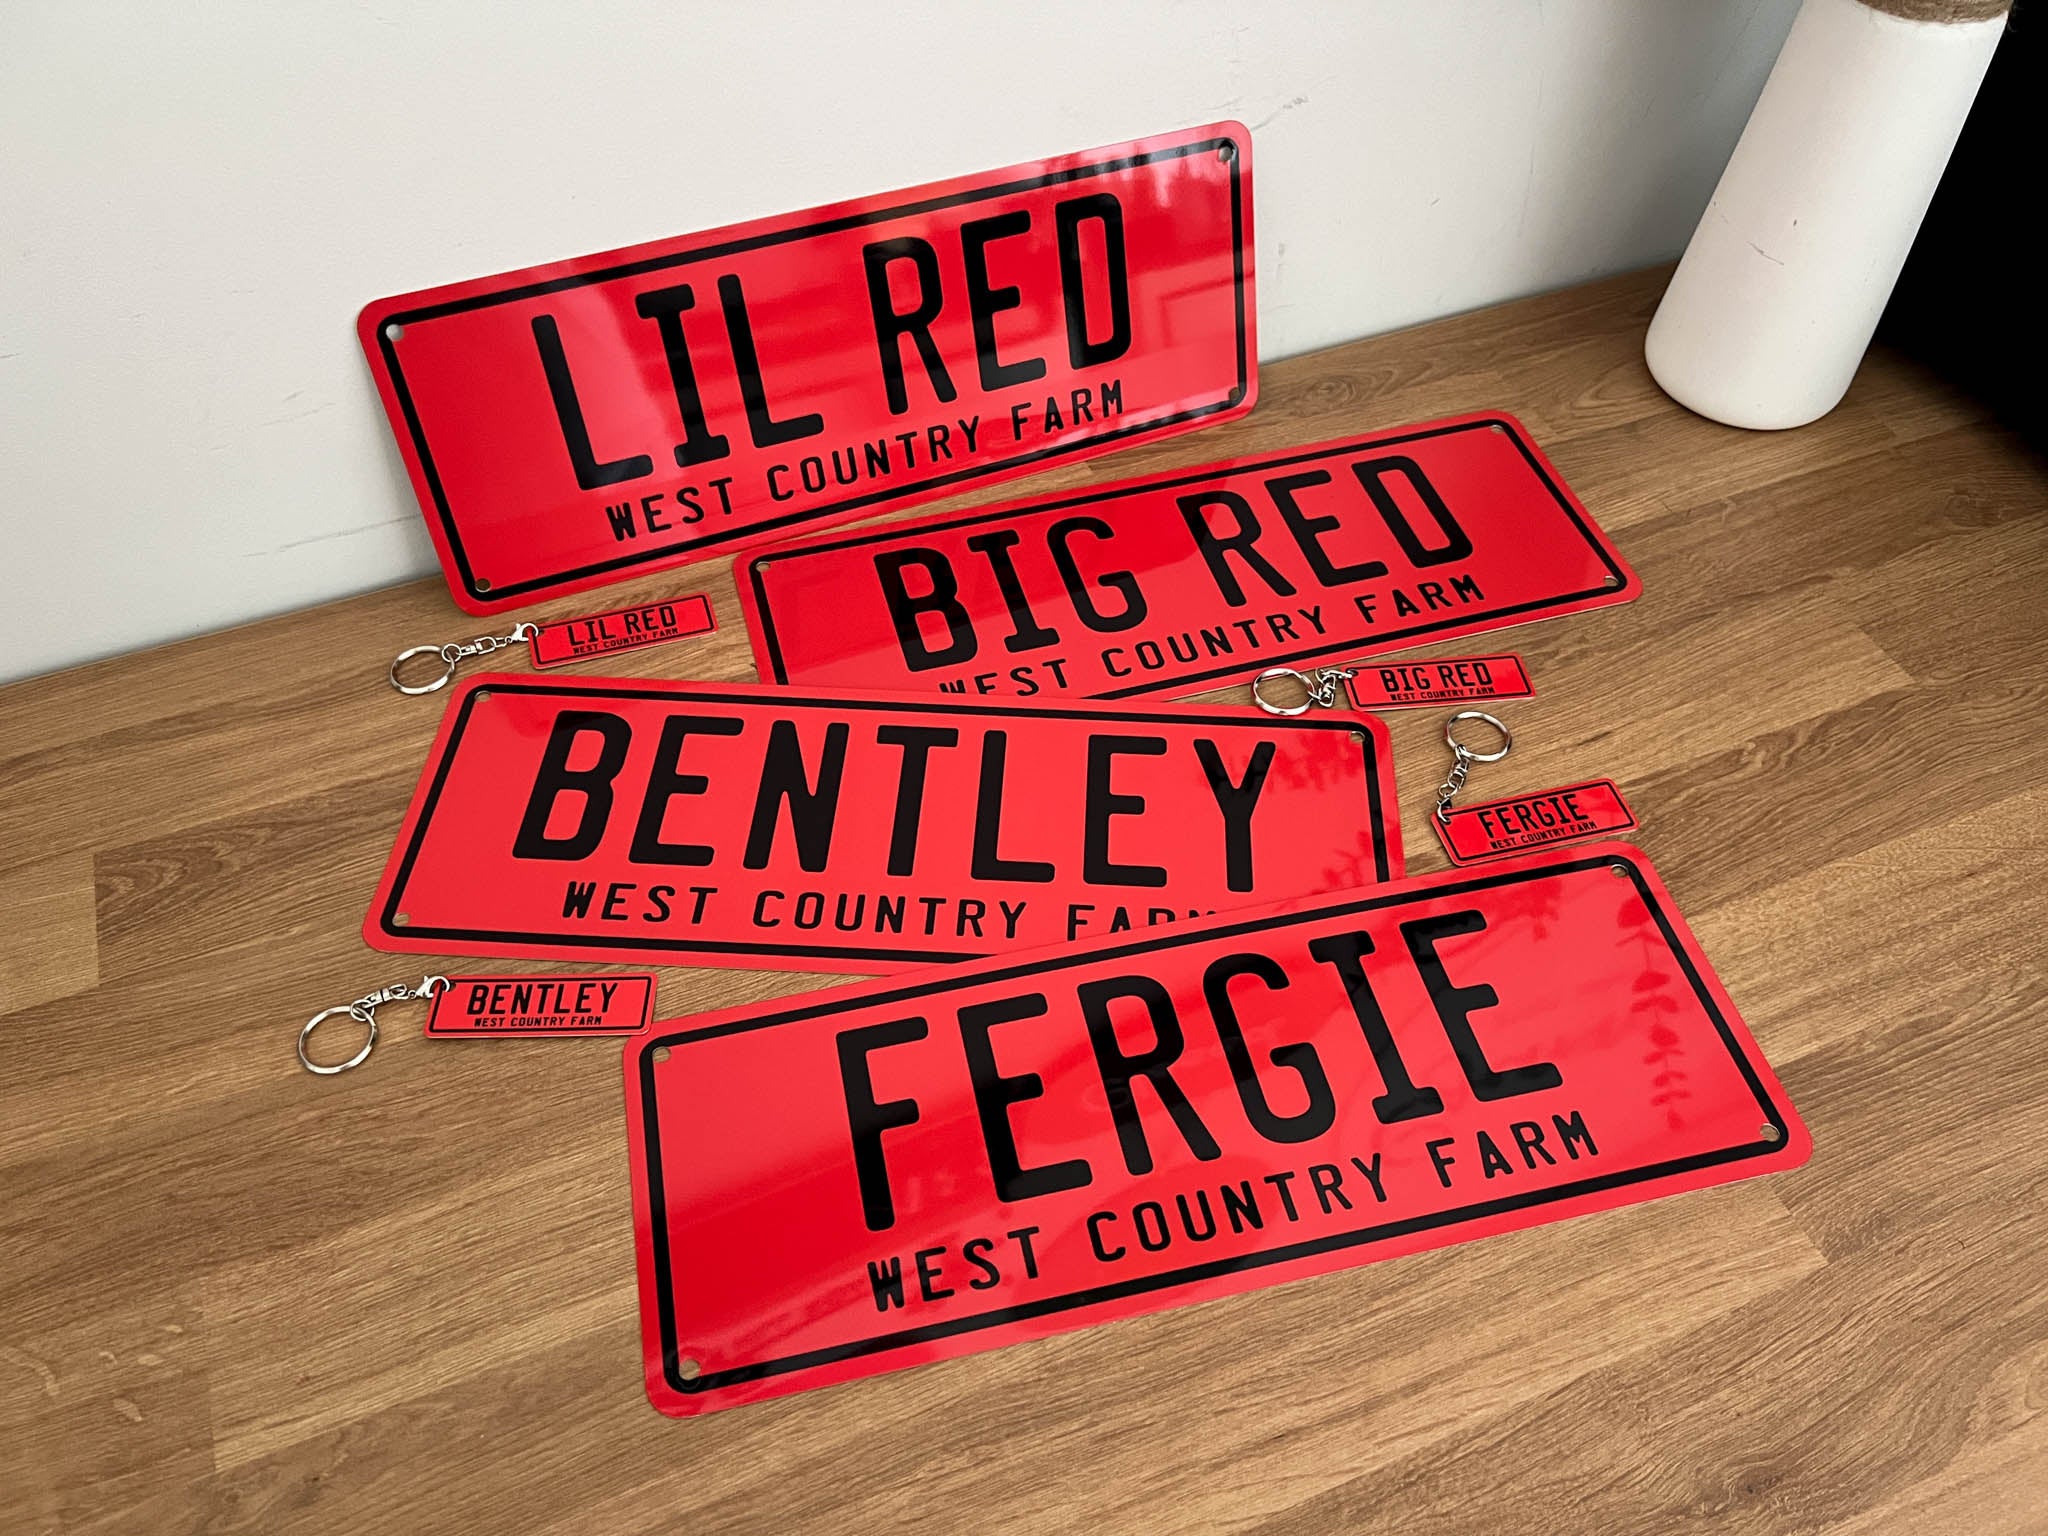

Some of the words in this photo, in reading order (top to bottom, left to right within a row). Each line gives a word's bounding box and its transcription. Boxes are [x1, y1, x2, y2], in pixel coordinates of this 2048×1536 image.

[531, 275, 825, 491] LIL
[862, 192, 1132, 416] RED
[606, 477, 733, 542] WEST
[767, 415, 979, 502] COUNTRY
[1011, 379, 1123, 441] FARM
[873, 516, 1148, 673] BIG
[1175, 455, 1474, 608] RED
[567, 619, 616, 646] LIL
[624, 605, 677, 635] RED
[573, 643, 598, 655] WEST
[604, 634, 648, 649] COUNTRY
[1101, 605, 1326, 677] COUNTRY
[1354, 574, 1485, 624] FARM
[1379, 667, 1431, 693] BIG
[1437, 662, 1493, 688] RED
[1420, 690, 1464, 700] COUNTRY
[512, 710, 1276, 893] BENTLEY
[1477, 793, 1589, 839] FERGIE
[1489, 838, 1517, 849] WEST
[1520, 827, 1567, 843] COUNTRY
[1571, 821, 1598, 834] FARM
[562, 881, 718, 924] WEST
[752, 890, 1027, 939] COUNTRY
[1067, 904, 1217, 942] FA
[467, 983, 618, 1015] BENTLEY
[474, 1017, 506, 1027] WEST
[510, 1017, 566, 1027] COUNTRY
[570, 1016, 602, 1026] FARM
[835, 909, 1563, 1232] FERGIE
[867, 1226, 1040, 1312] WEST
[1086, 1152, 1387, 1262] COUNTRY
[1425, 1110, 1599, 1188] FARM
